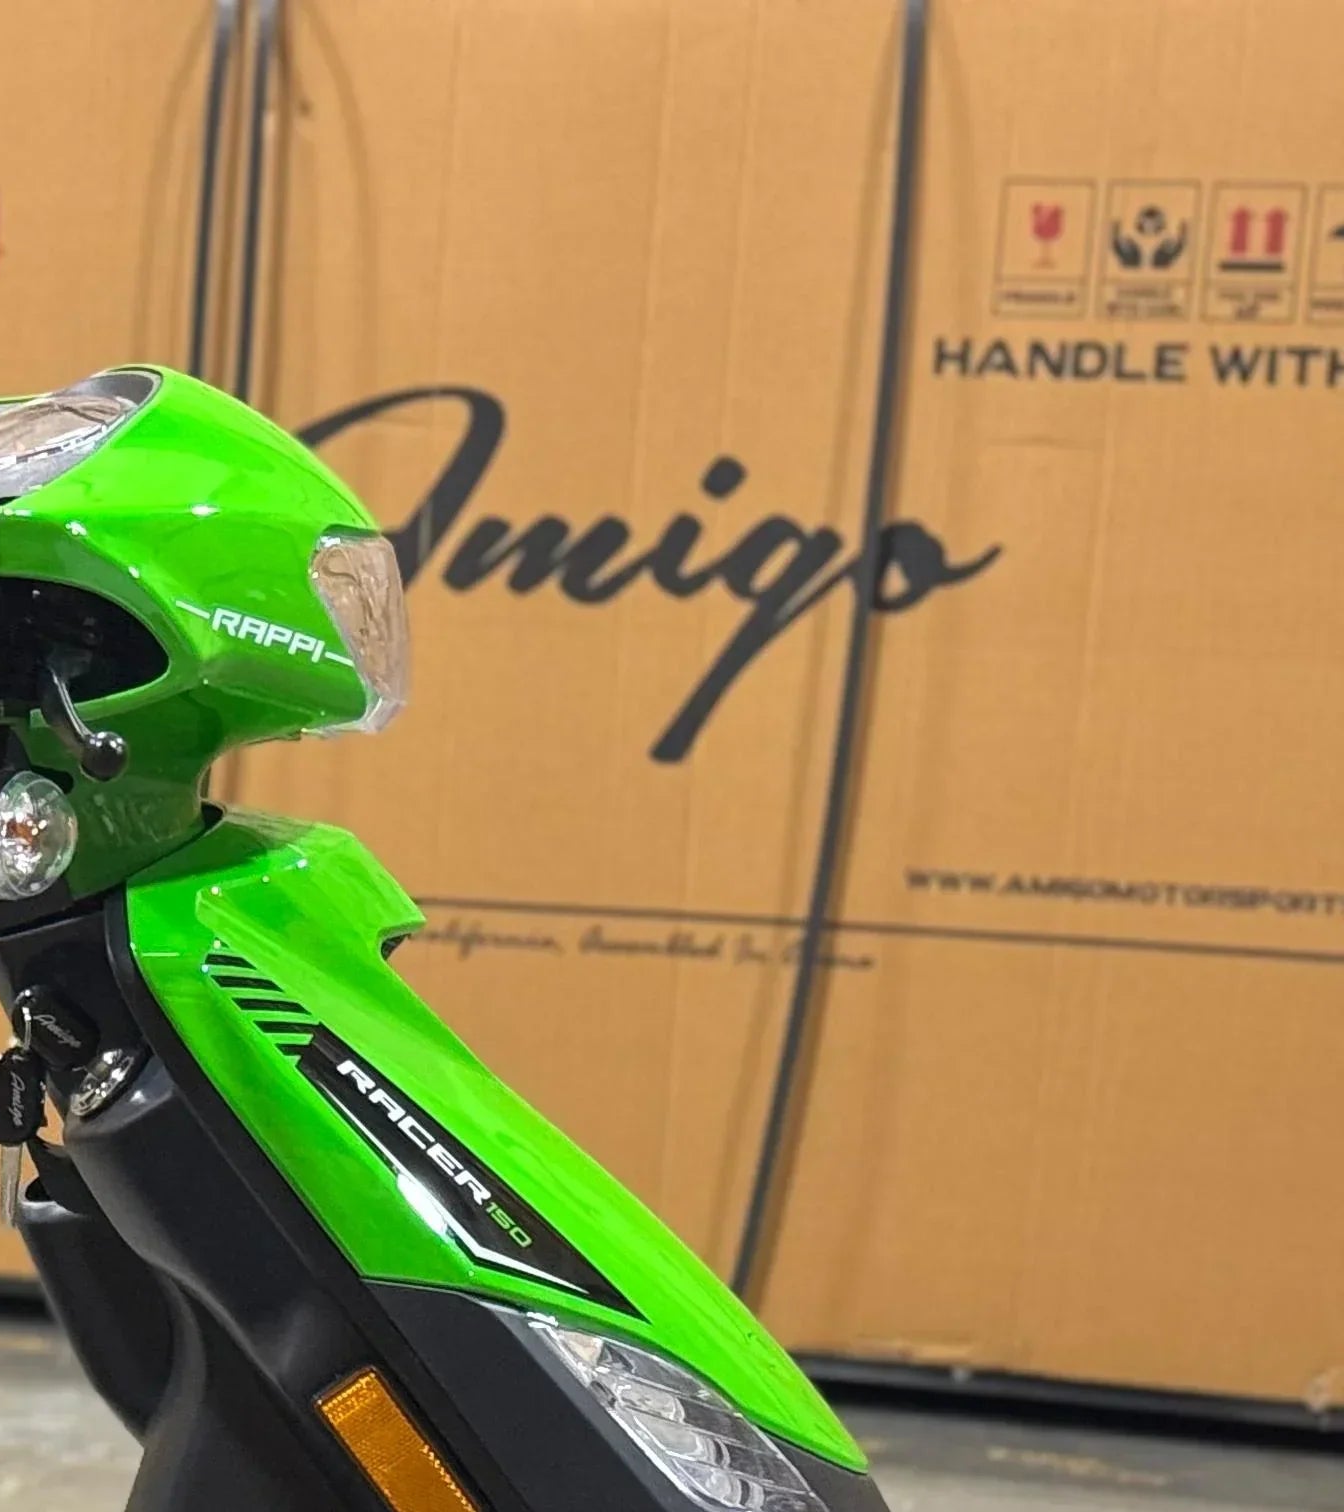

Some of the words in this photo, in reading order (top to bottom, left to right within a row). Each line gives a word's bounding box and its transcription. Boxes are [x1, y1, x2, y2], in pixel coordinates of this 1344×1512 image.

[932, 337, 1189, 384] HANDLE
[211, 607, 326, 664] RAPPI
[336, 1058, 492, 1206] RACER
[485, 1201, 533, 1249] 150
